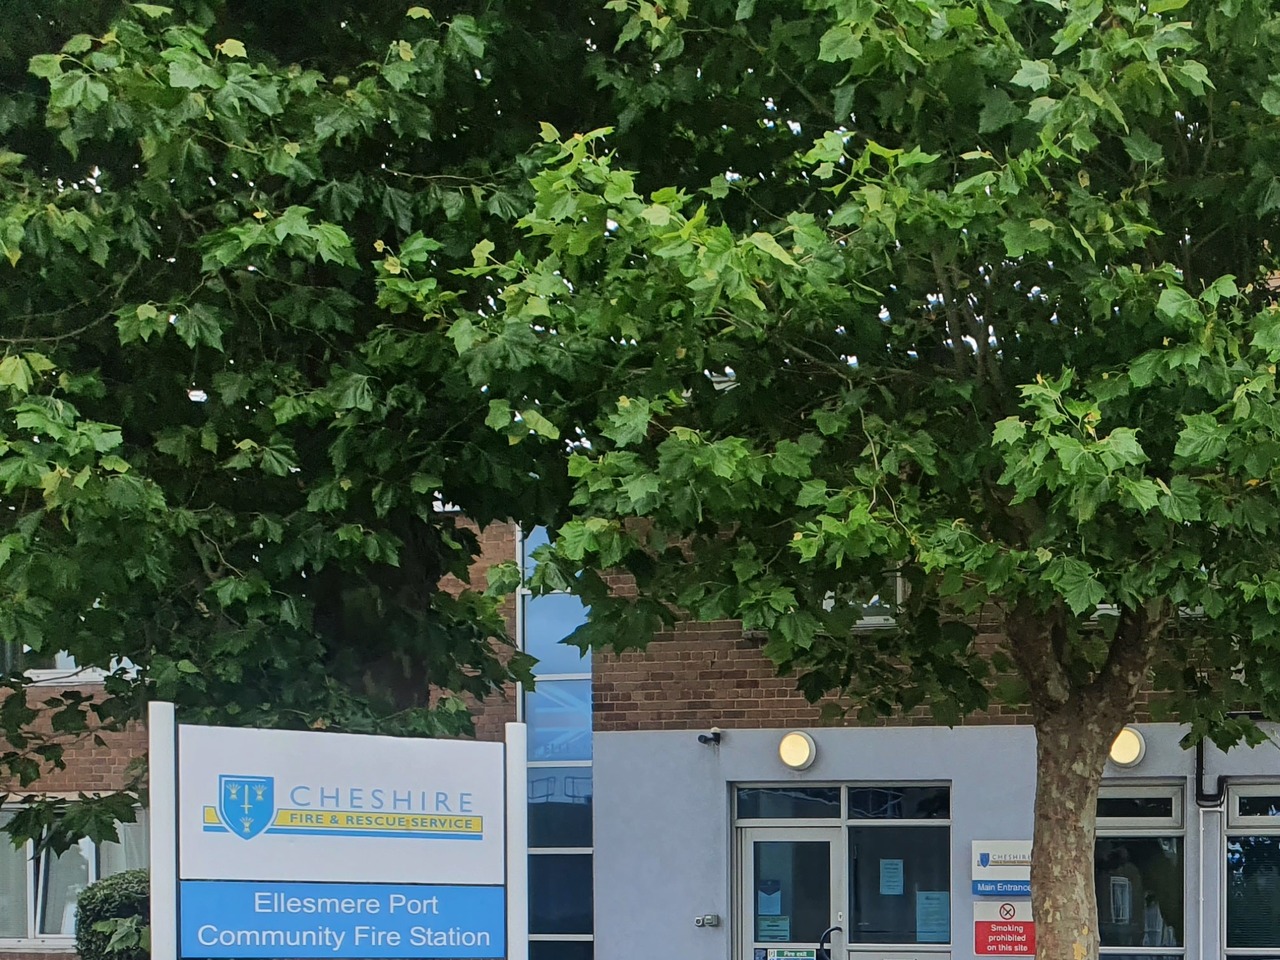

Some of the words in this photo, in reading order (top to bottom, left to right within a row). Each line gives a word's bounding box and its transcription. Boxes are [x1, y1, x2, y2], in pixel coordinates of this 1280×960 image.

[290, 785, 473, 812] CHESHIRE
[290, 813, 324, 824] FIRE
[329, 815, 340, 825] &
[346, 816, 407, 827] RESCUE
[411, 818, 473, 829] SERVICE
[977, 883, 996, 891] Main
[254, 892, 381, 914] Ellesmere
[389, 893, 440, 915] Port
[990, 924, 1024, 933] Smoking
[197, 924, 346, 951] Community
[354, 926, 401, 946] Fire
[409, 926, 491, 947] Station
[988, 934, 1026, 942] prohibited
